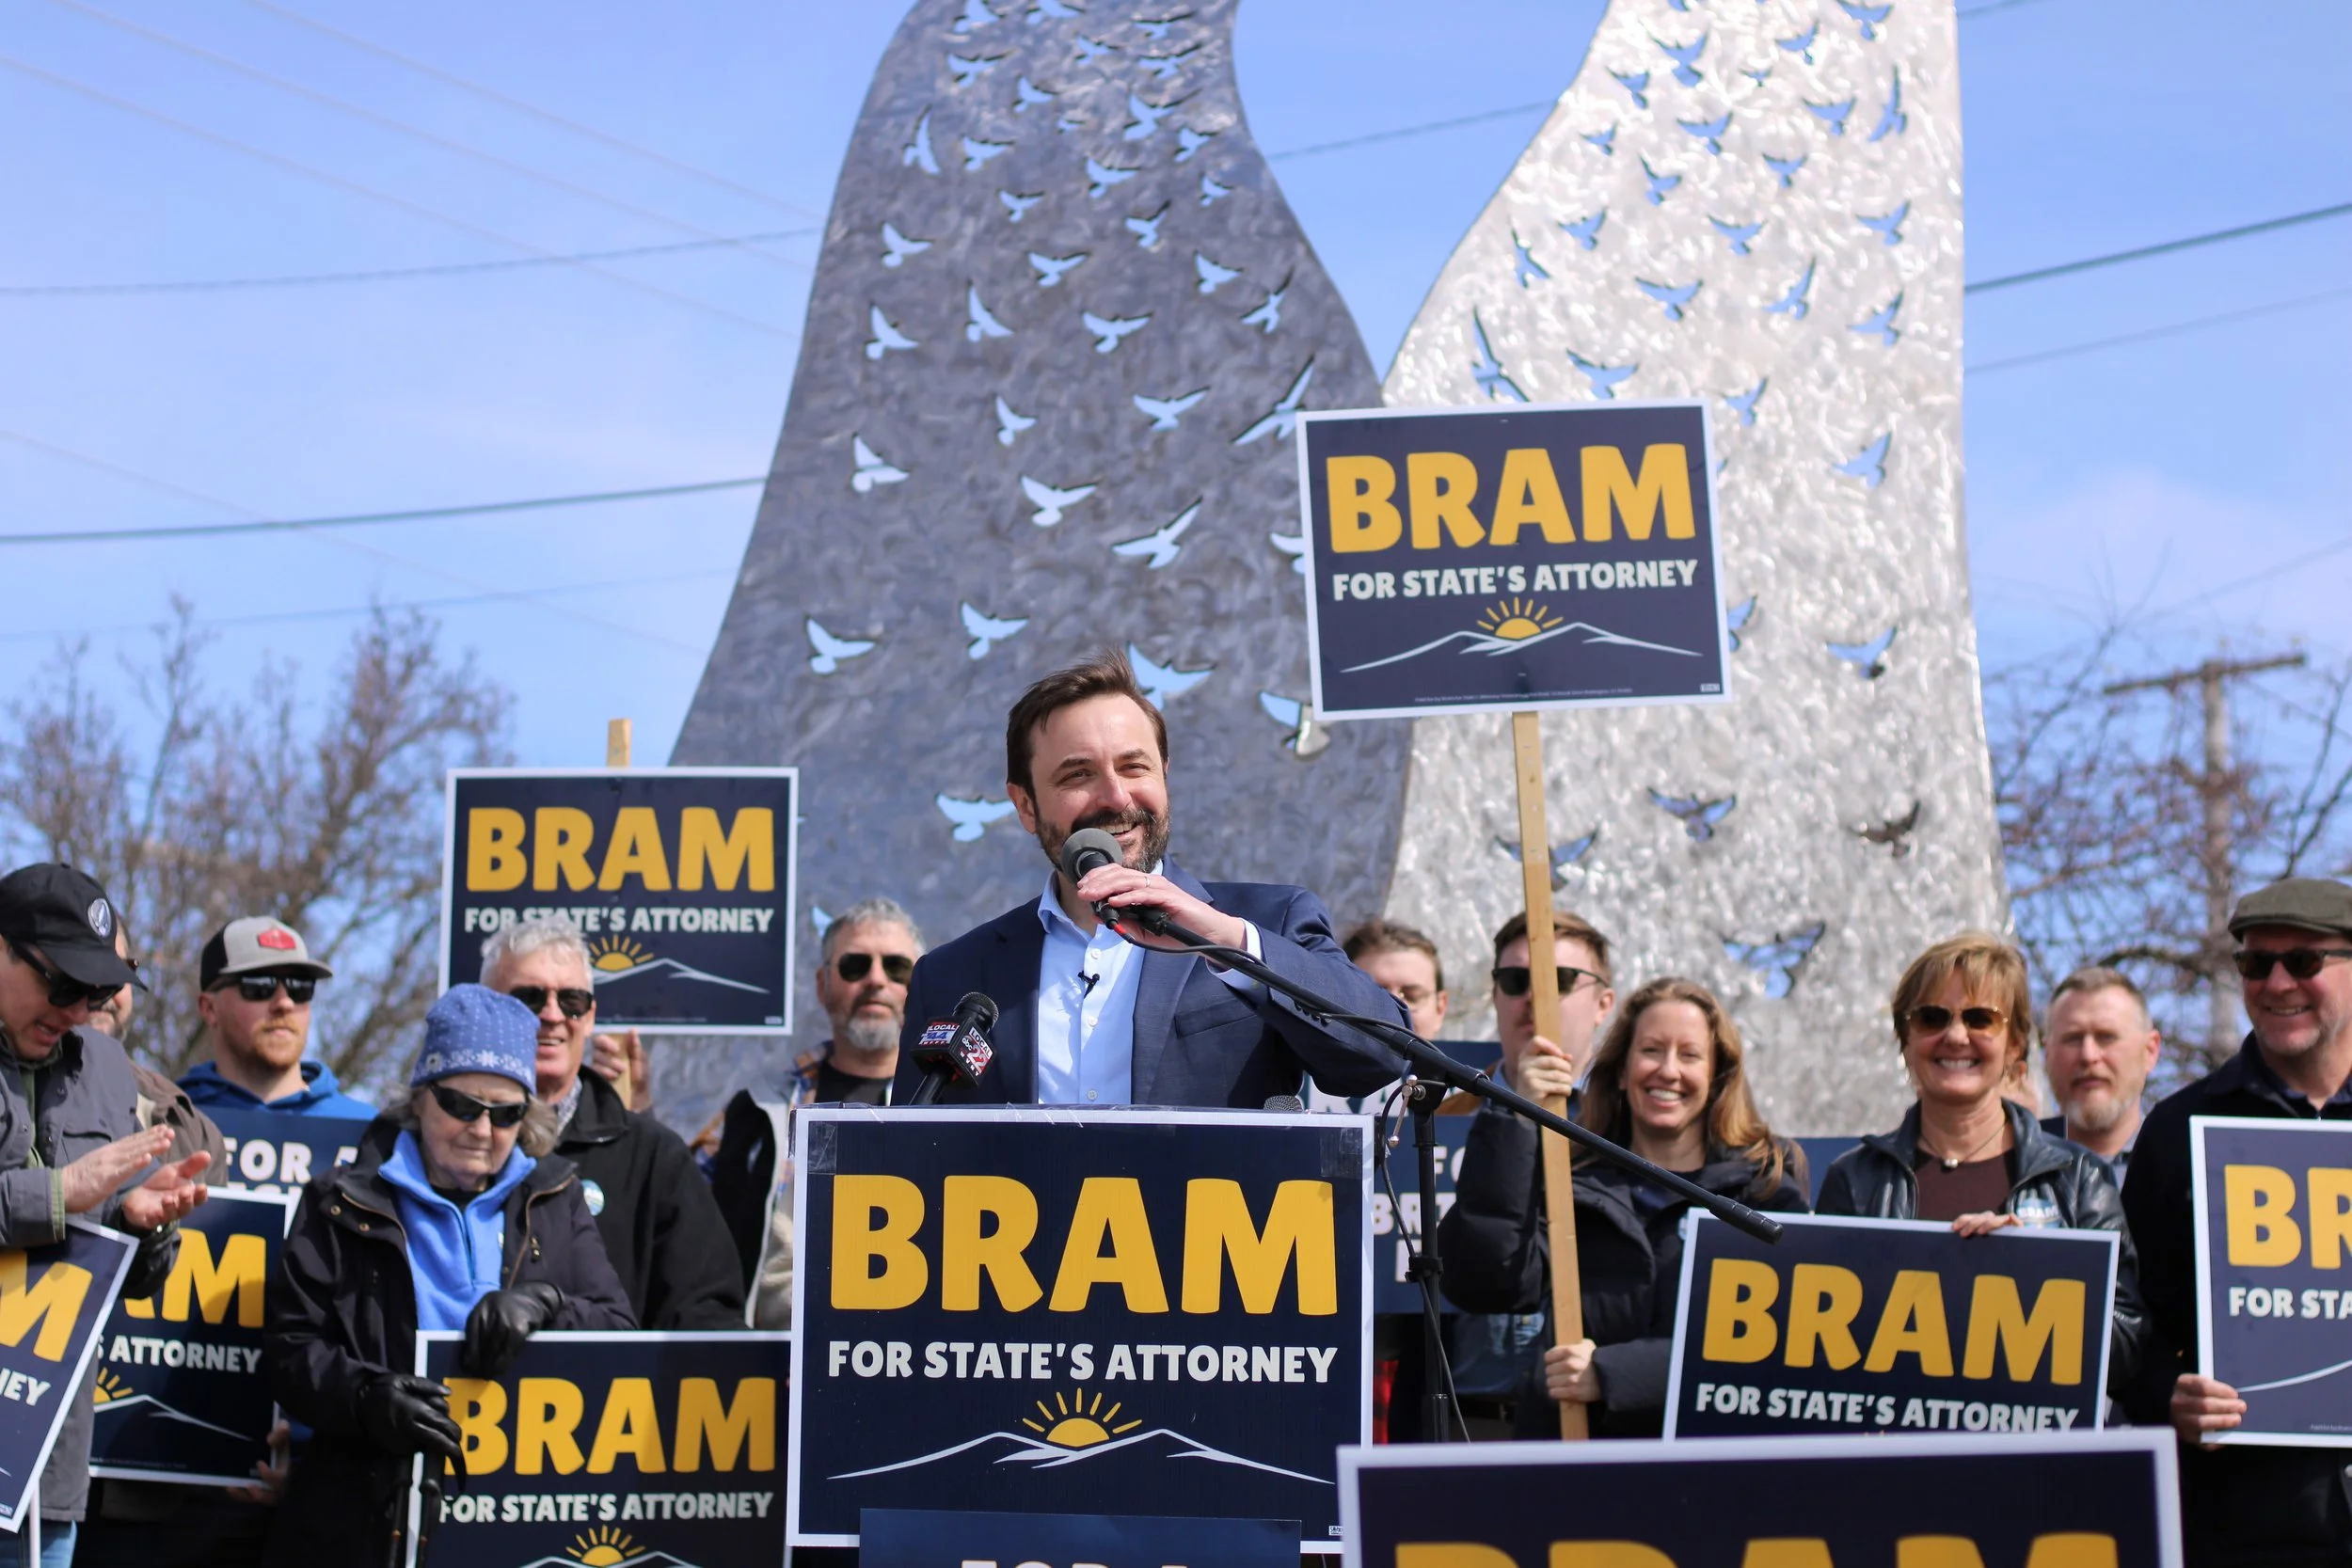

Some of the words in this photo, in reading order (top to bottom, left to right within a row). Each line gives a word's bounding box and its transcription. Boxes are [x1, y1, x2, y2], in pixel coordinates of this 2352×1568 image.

[1327, 443, 1695, 553] BRAM
[1333, 572, 1396, 601] FOR
[1402, 565, 1527, 598] STATE'S
[1534, 559, 1698, 593] ATTORNEY
[467, 807, 775, 892] BRAM
[465, 908, 517, 933] FOR
[630, 908, 774, 933] ATTORNEY
[966, 1043, 988, 1074] 22
[971, 1028, 992, 1058] LOCAL
[830, 1174, 1338, 1316] BRAM
[1702, 1258, 2086, 1386] BRAM
[2229, 1287, 2296, 1319] FOR
[108, 1335, 262, 1374] ATTORNEY
[828, 1340, 914, 1378] FOR
[923, 1341, 1095, 1381] STATE'S
[1104, 1344, 1339, 1384] ATTORNEY
[443, 1377, 775, 1476] BRAM
[1696, 1383, 1761, 1415] FOR
[1767, 1388, 1896, 1425] STATE'S
[1900, 1398, 2080, 1433] ATTORNEY
[439, 1495, 496, 1524] FOR
[501, 1494, 617, 1523] STATE'S
[620, 1492, 774, 1521] ATTORNEY
